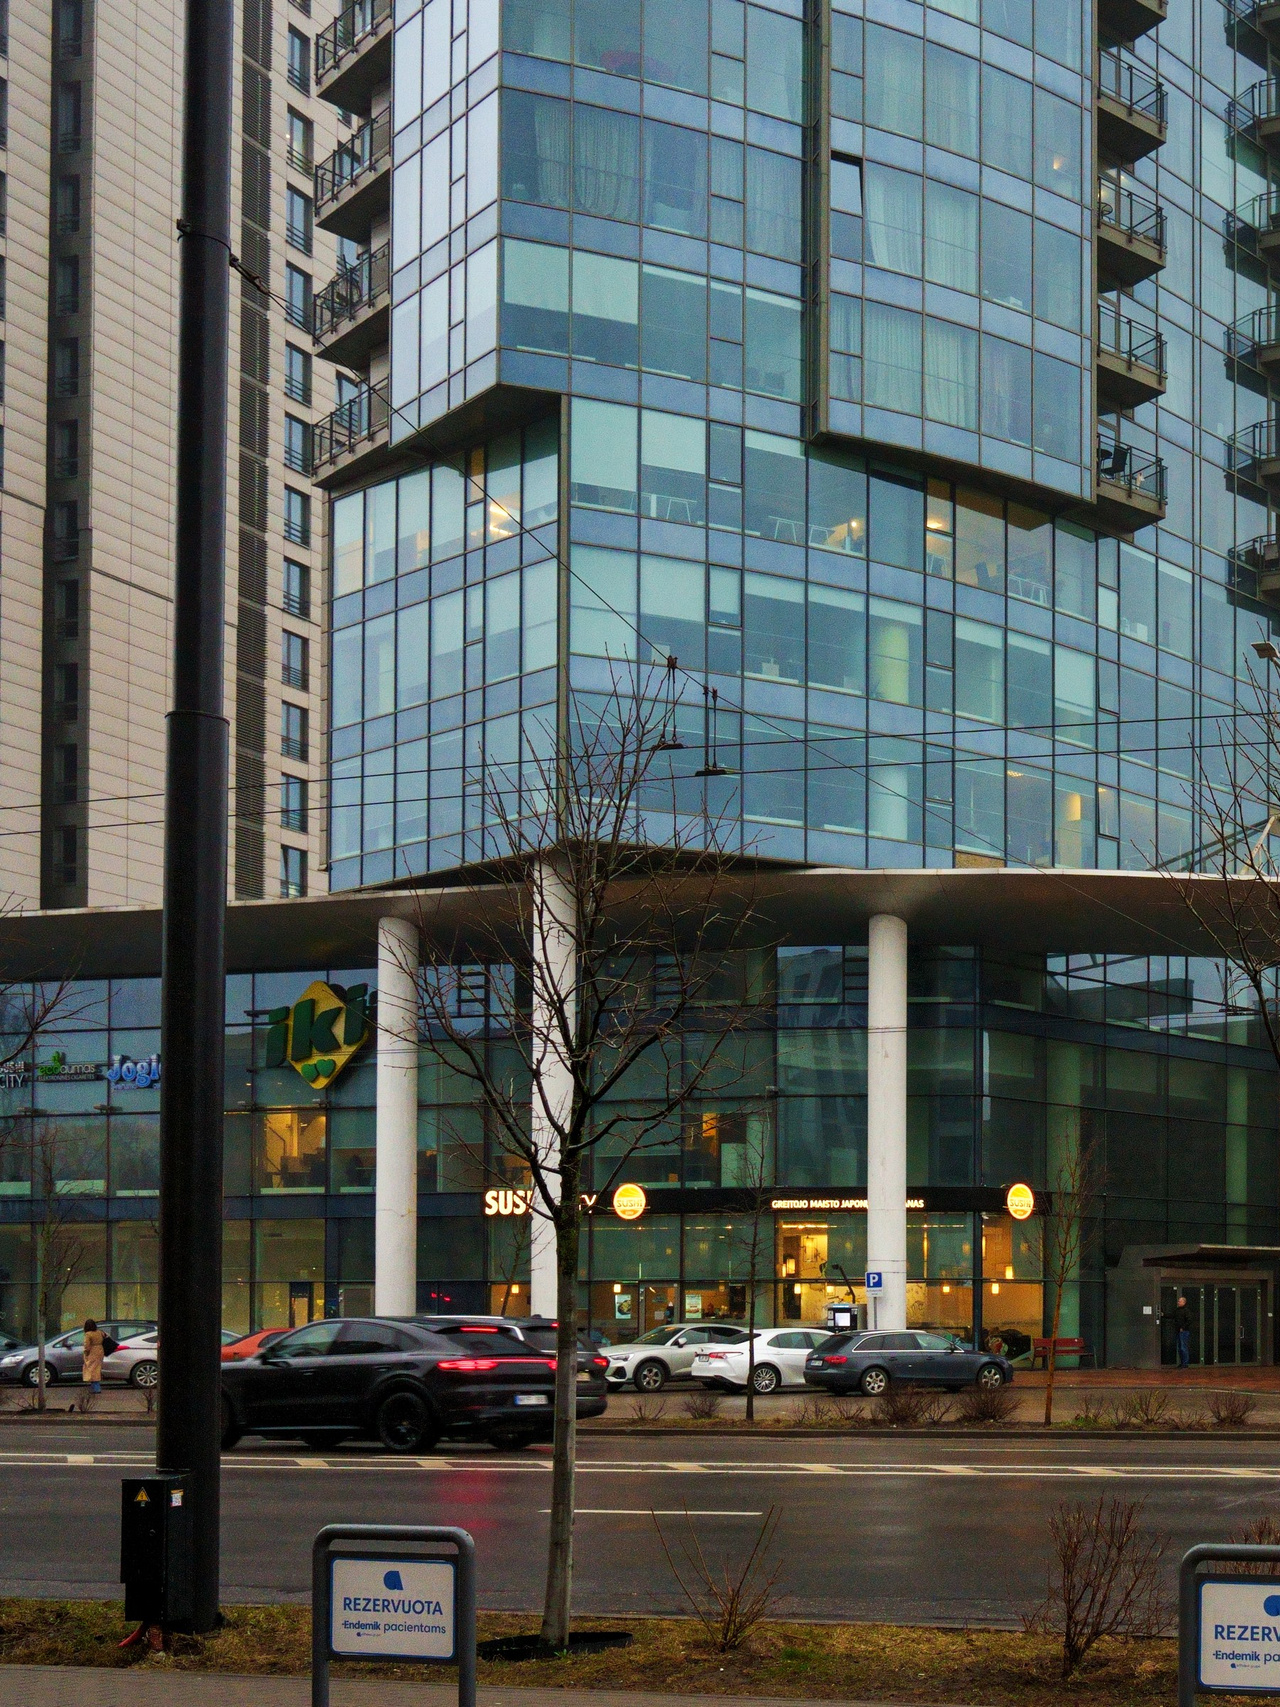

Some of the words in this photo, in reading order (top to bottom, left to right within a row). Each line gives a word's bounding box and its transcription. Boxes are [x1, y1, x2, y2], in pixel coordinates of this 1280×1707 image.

[266, 982, 368, 1069] iki
[107, 1054, 161, 1087] Jogl
[771, 1200, 808, 1208] GREITOJO
[810, 1200, 839, 1208] MAISTO
[869, 1274, 879, 1287] P
[343, 1597, 443, 1615] REZERVUOTA
[383, 1621, 447, 1634] pacientams
